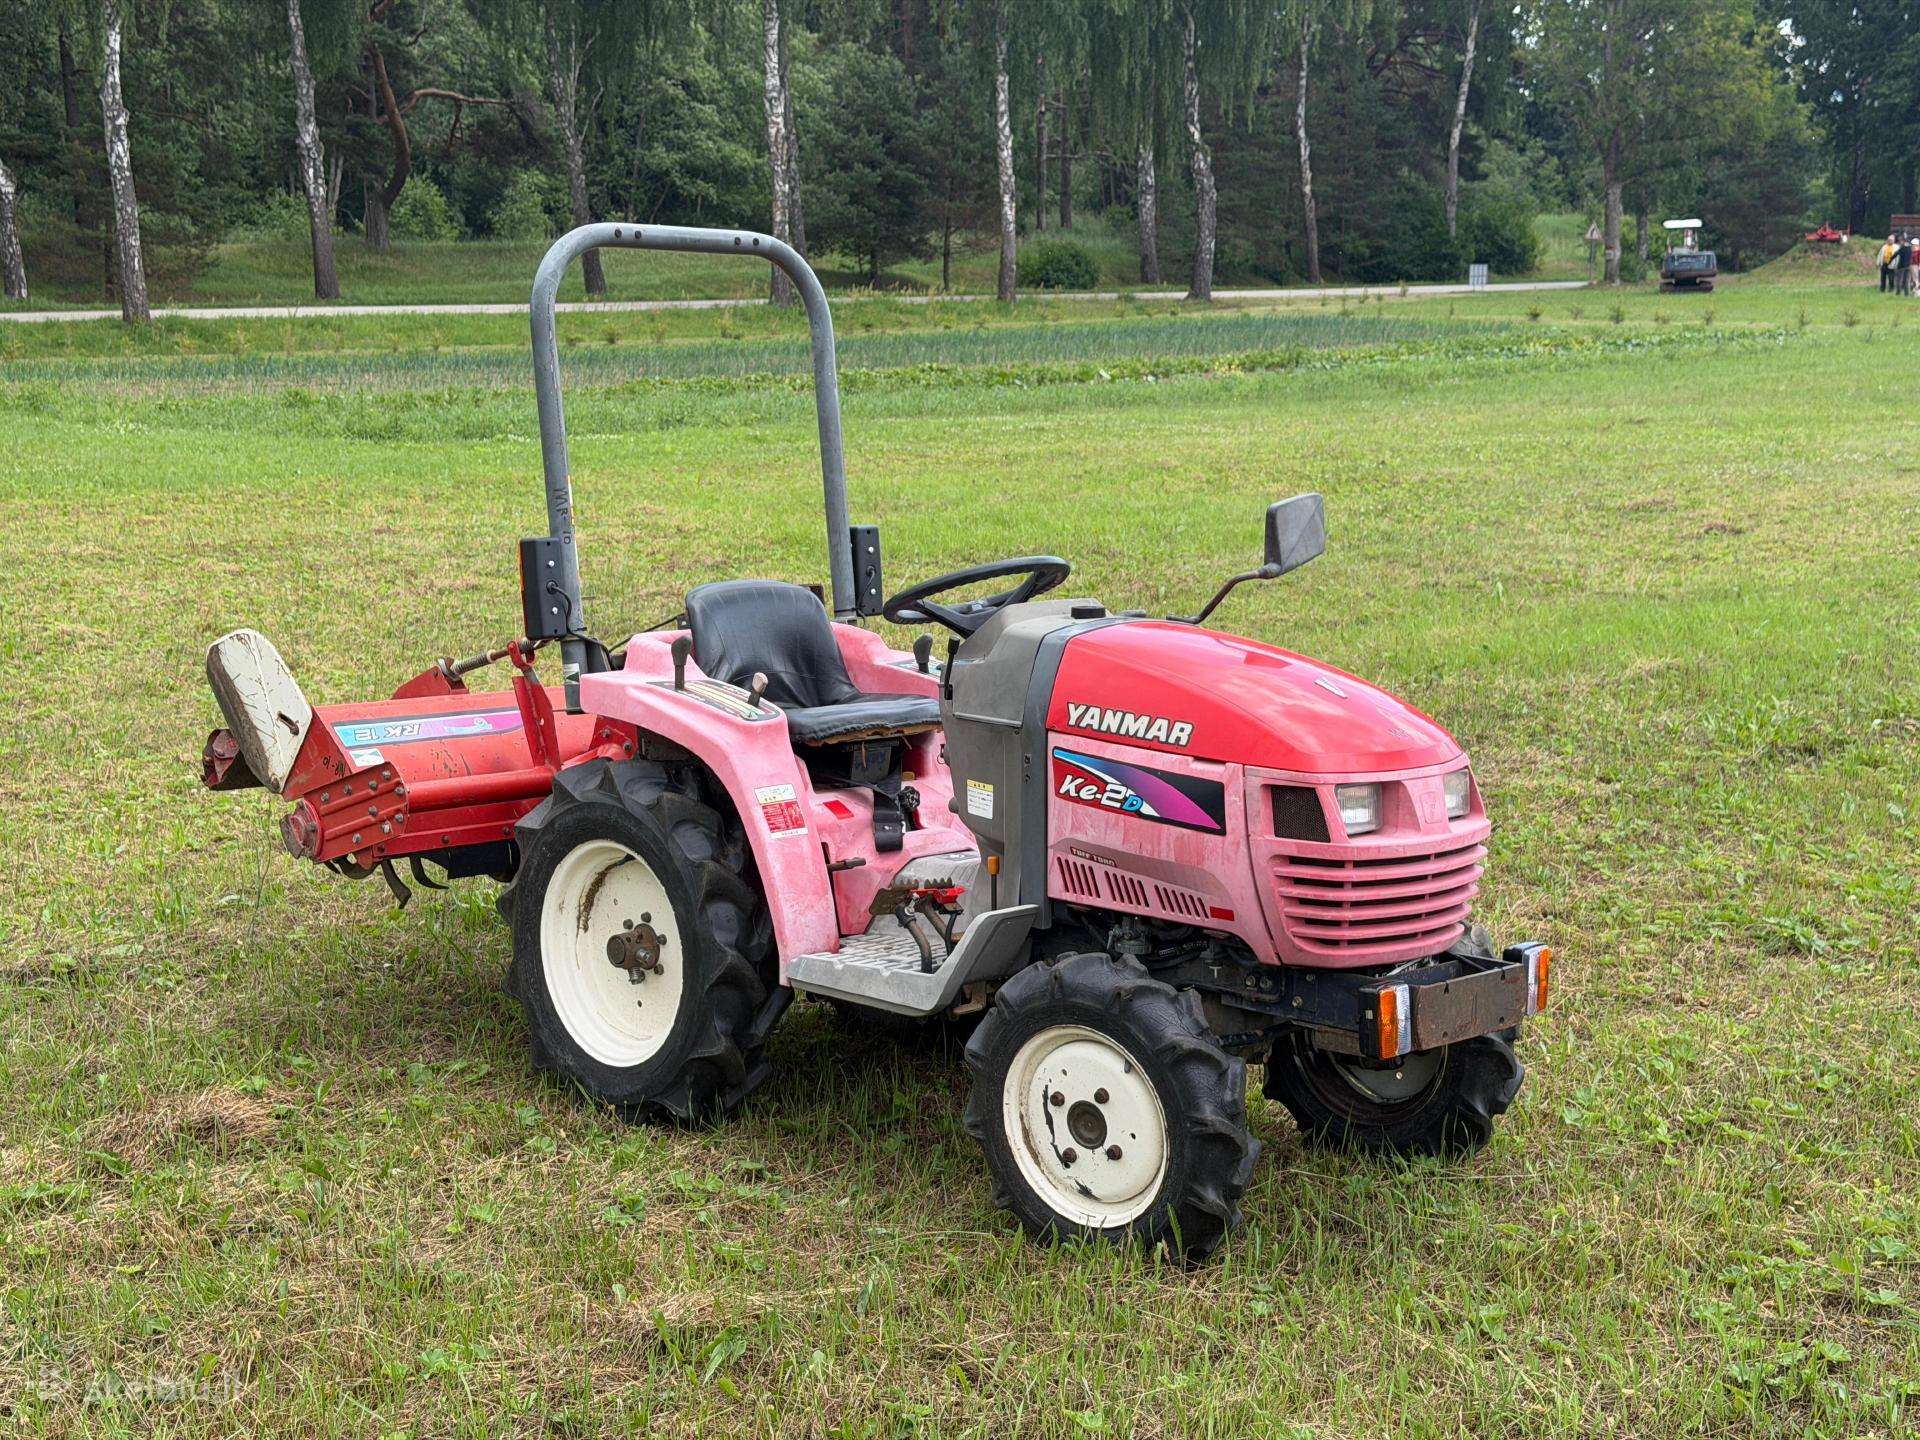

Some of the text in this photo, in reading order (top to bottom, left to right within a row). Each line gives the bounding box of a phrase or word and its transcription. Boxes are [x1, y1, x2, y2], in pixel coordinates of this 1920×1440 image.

[353, 722, 421, 742] RK 12
[1067, 701, 1194, 747] YANMAR
